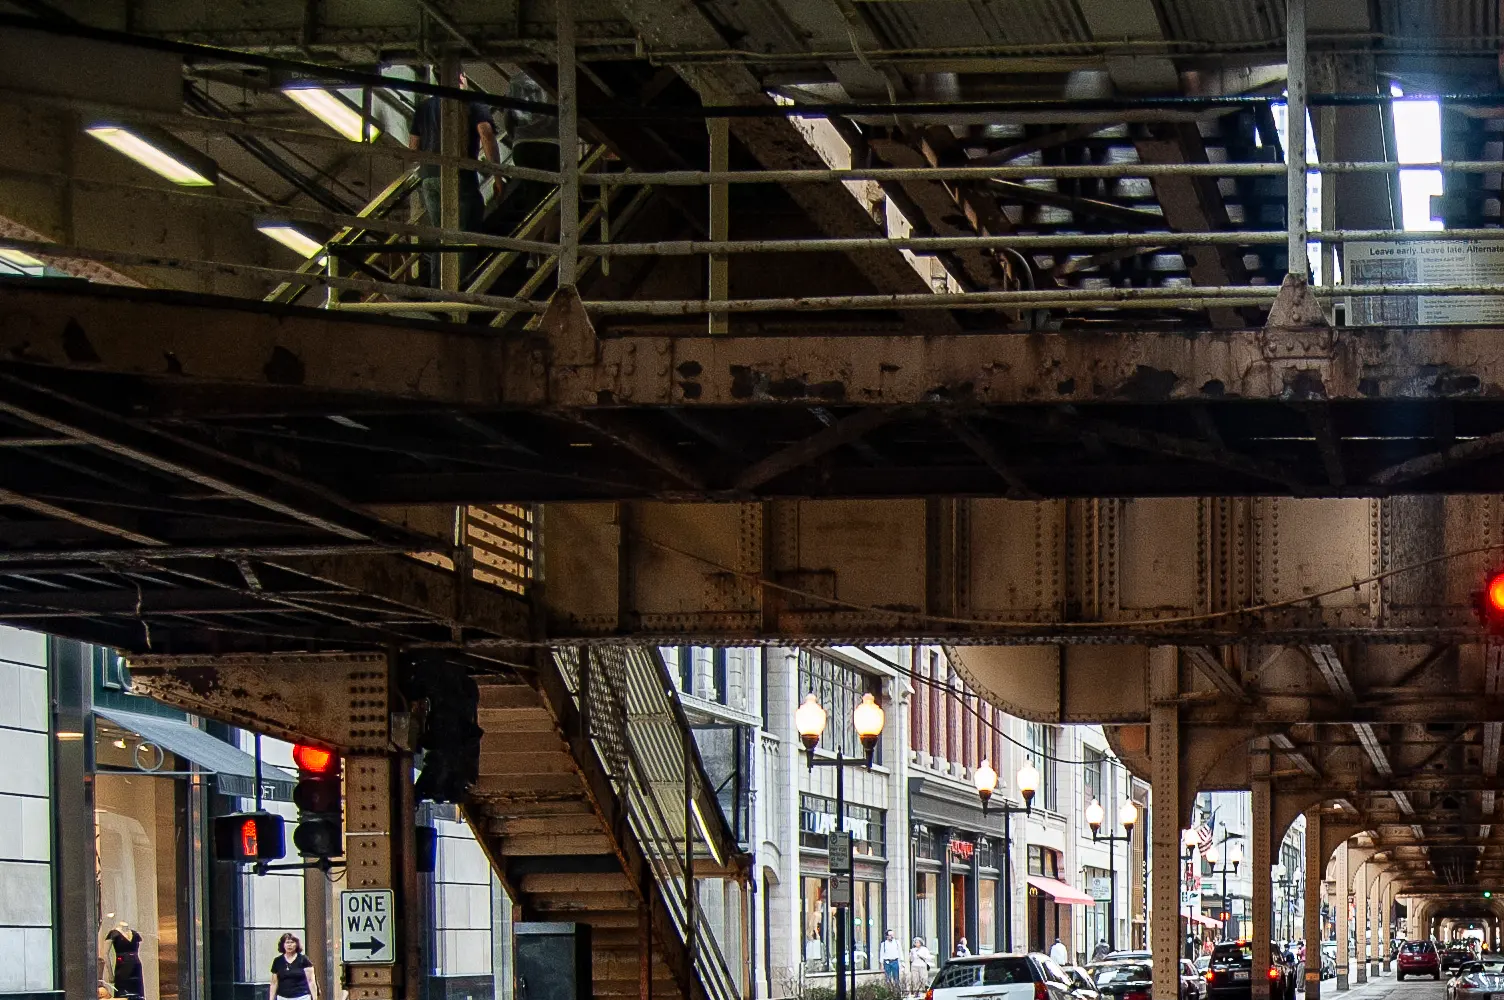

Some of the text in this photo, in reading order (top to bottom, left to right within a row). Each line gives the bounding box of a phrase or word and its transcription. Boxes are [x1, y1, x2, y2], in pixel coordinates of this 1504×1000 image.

[1369, 247, 1394, 256] Leave
[1420, 246, 1445, 255] Leave
[348, 895, 386, 913] ONE
[347, 915, 387, 932] WAY
